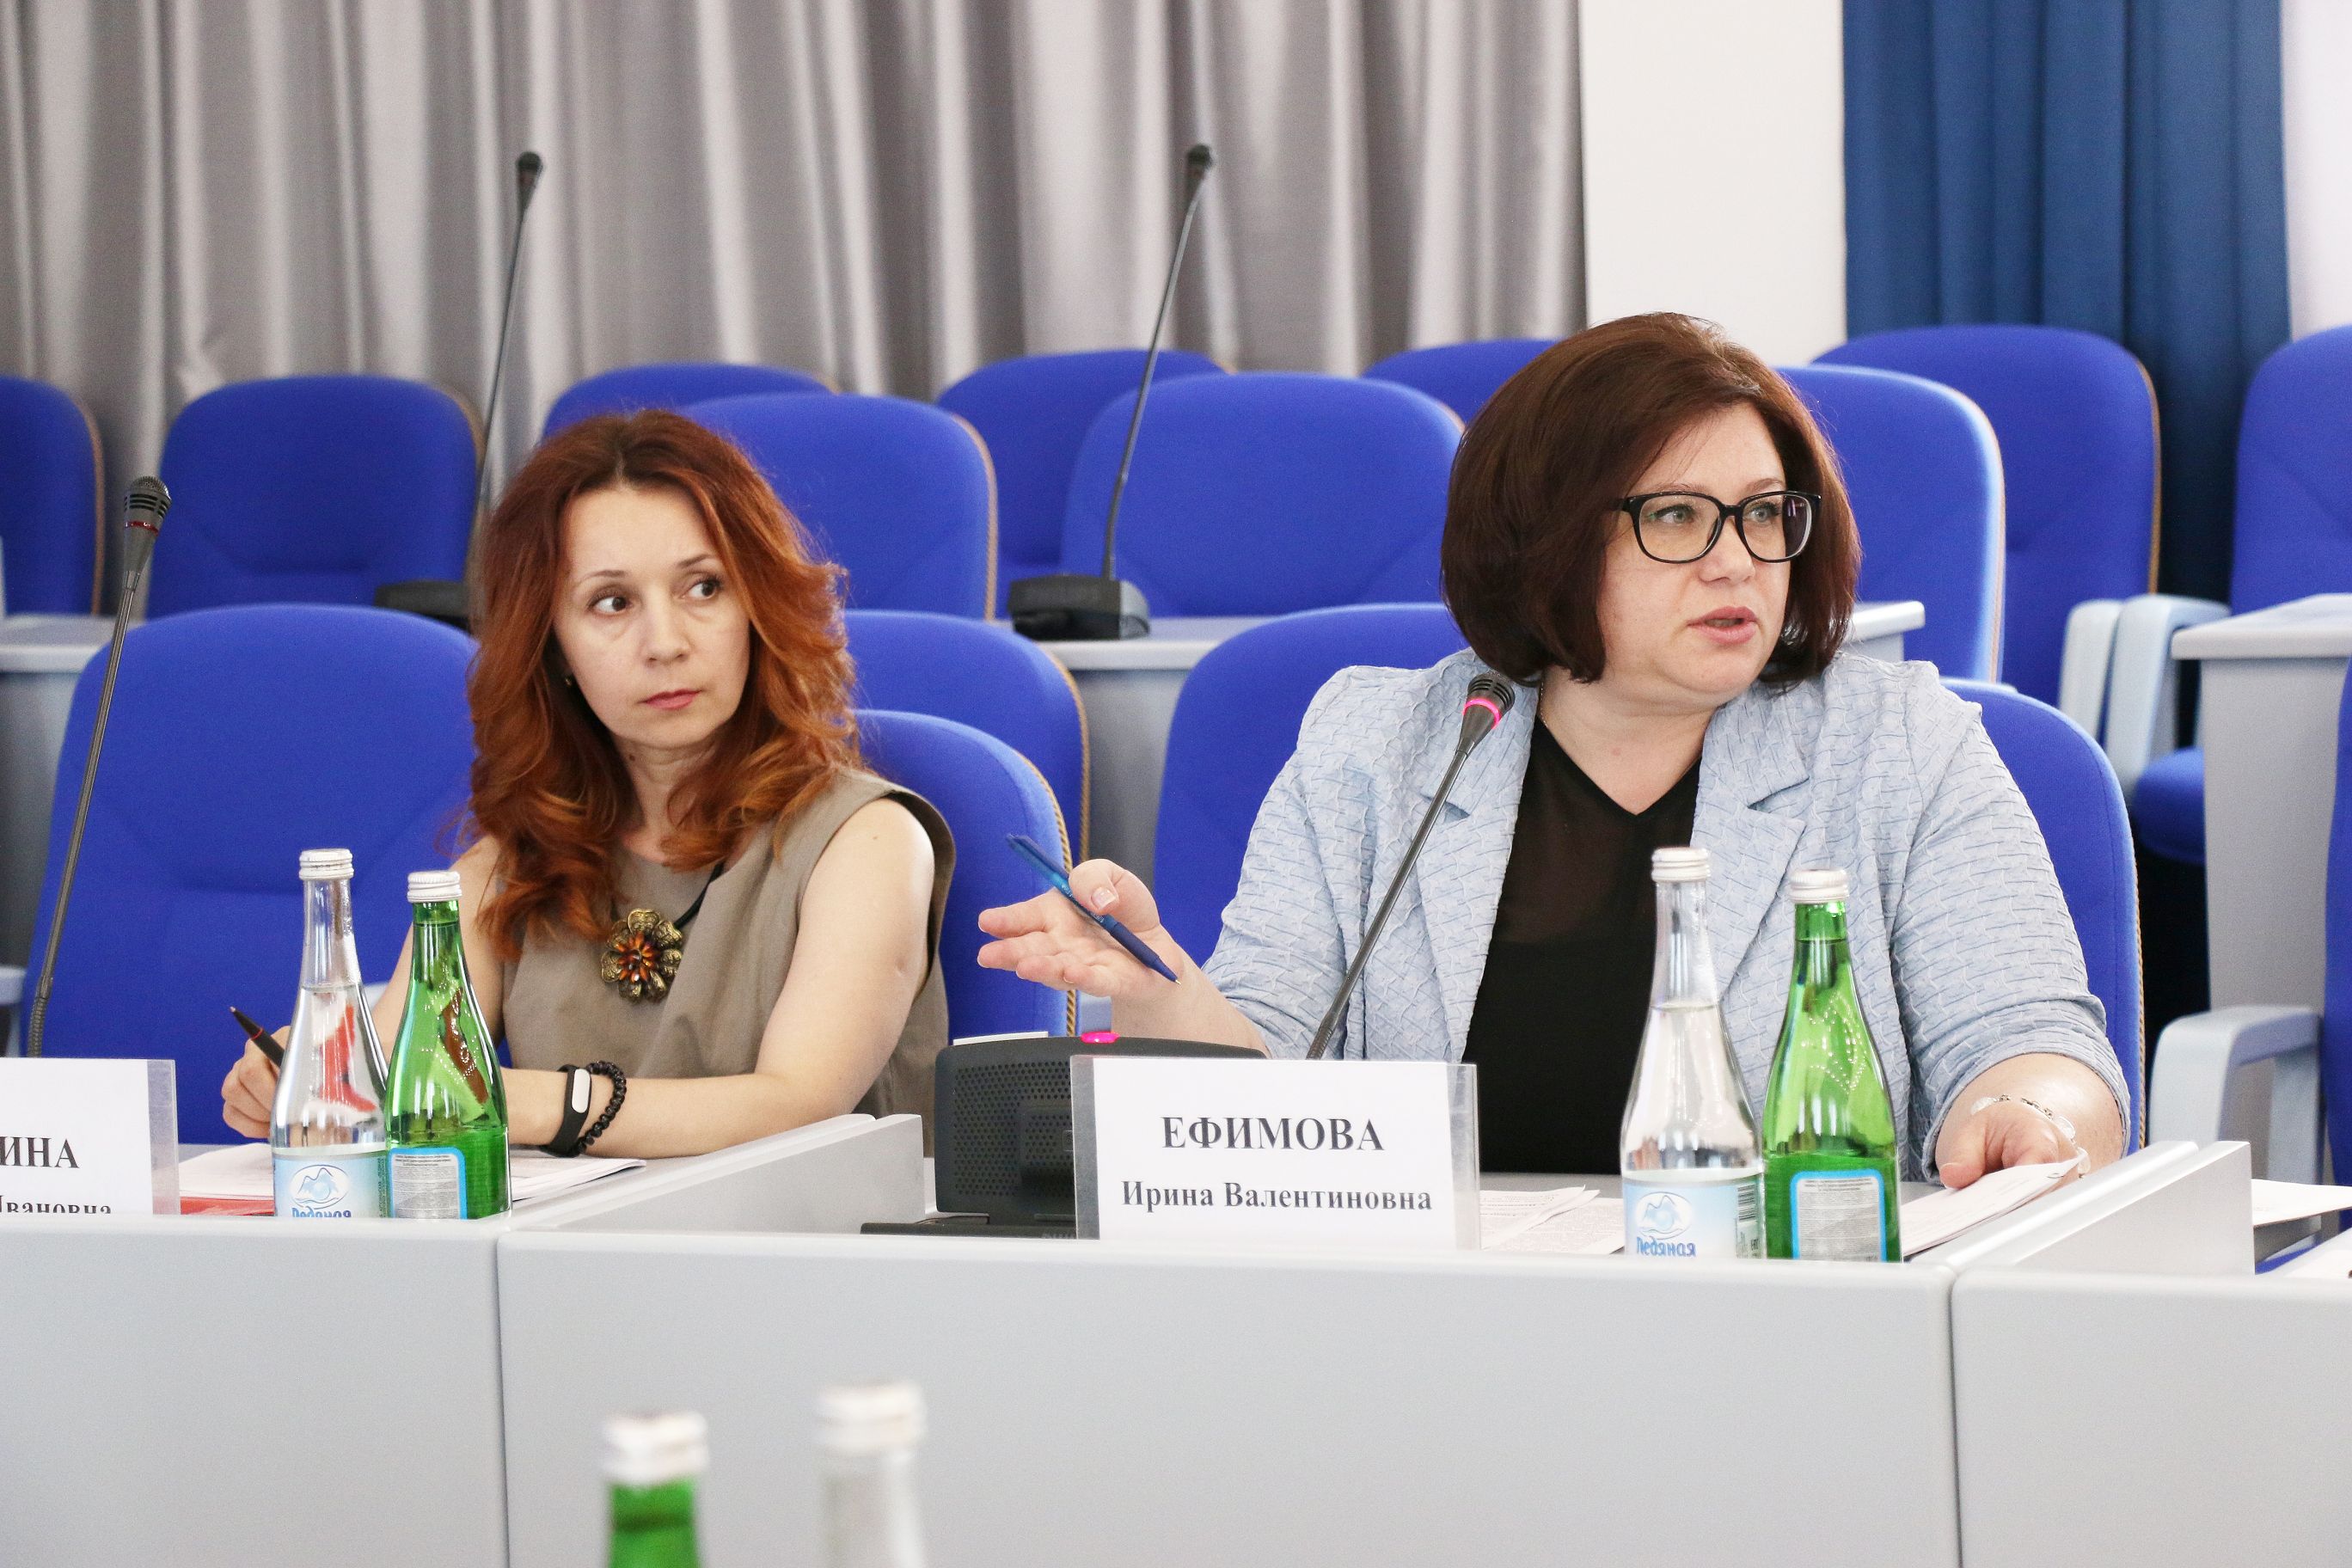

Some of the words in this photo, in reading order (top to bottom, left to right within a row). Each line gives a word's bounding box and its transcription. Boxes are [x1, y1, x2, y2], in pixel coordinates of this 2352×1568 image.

[1161, 1117, 1385, 1151] ЕФИМОВА
[0, 1136, 80, 1169] ИНА
[0, 1195, 111, 1214] вановна
[1123, 1180, 1214, 1213] Ирина
[1223, 1182, 1432, 1210] Валентиновна
